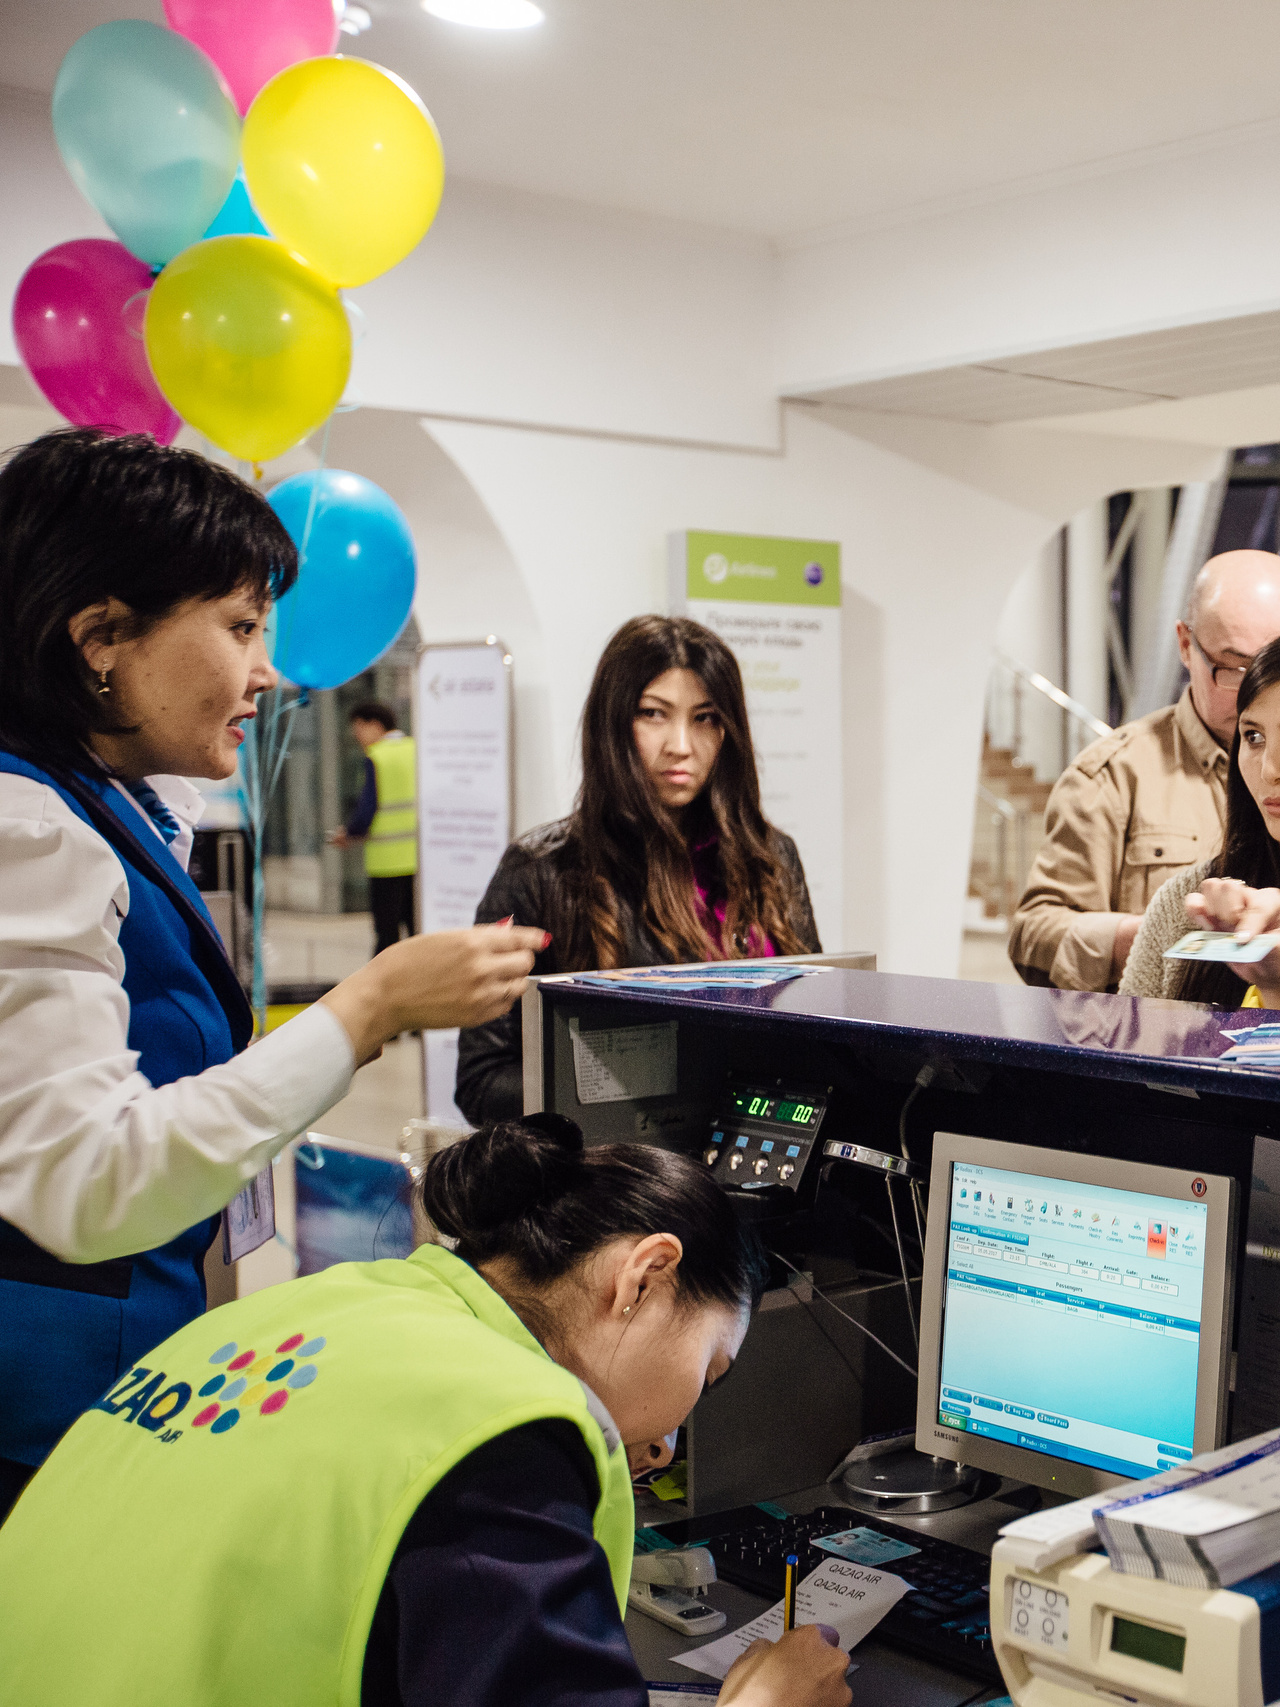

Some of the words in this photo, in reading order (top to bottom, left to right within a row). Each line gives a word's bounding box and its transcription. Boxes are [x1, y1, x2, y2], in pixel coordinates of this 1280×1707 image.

[1055, 1282, 1083, 1293] Passengers
[1067, 1297, 1085, 1306] Services
[1139, 1312, 1158, 1321] Balance
[92, 1367, 192, 1432] ZAQ
[154, 1428, 184, 1444] AIR
[933, 1430, 960, 1443] SAMSUNG
[829, 1563, 864, 1580] QAZAQ
[862, 1572, 882, 1585] AIR
[813, 1578, 848, 1595] QAZAQ
[846, 1588, 866, 1601] AIR
